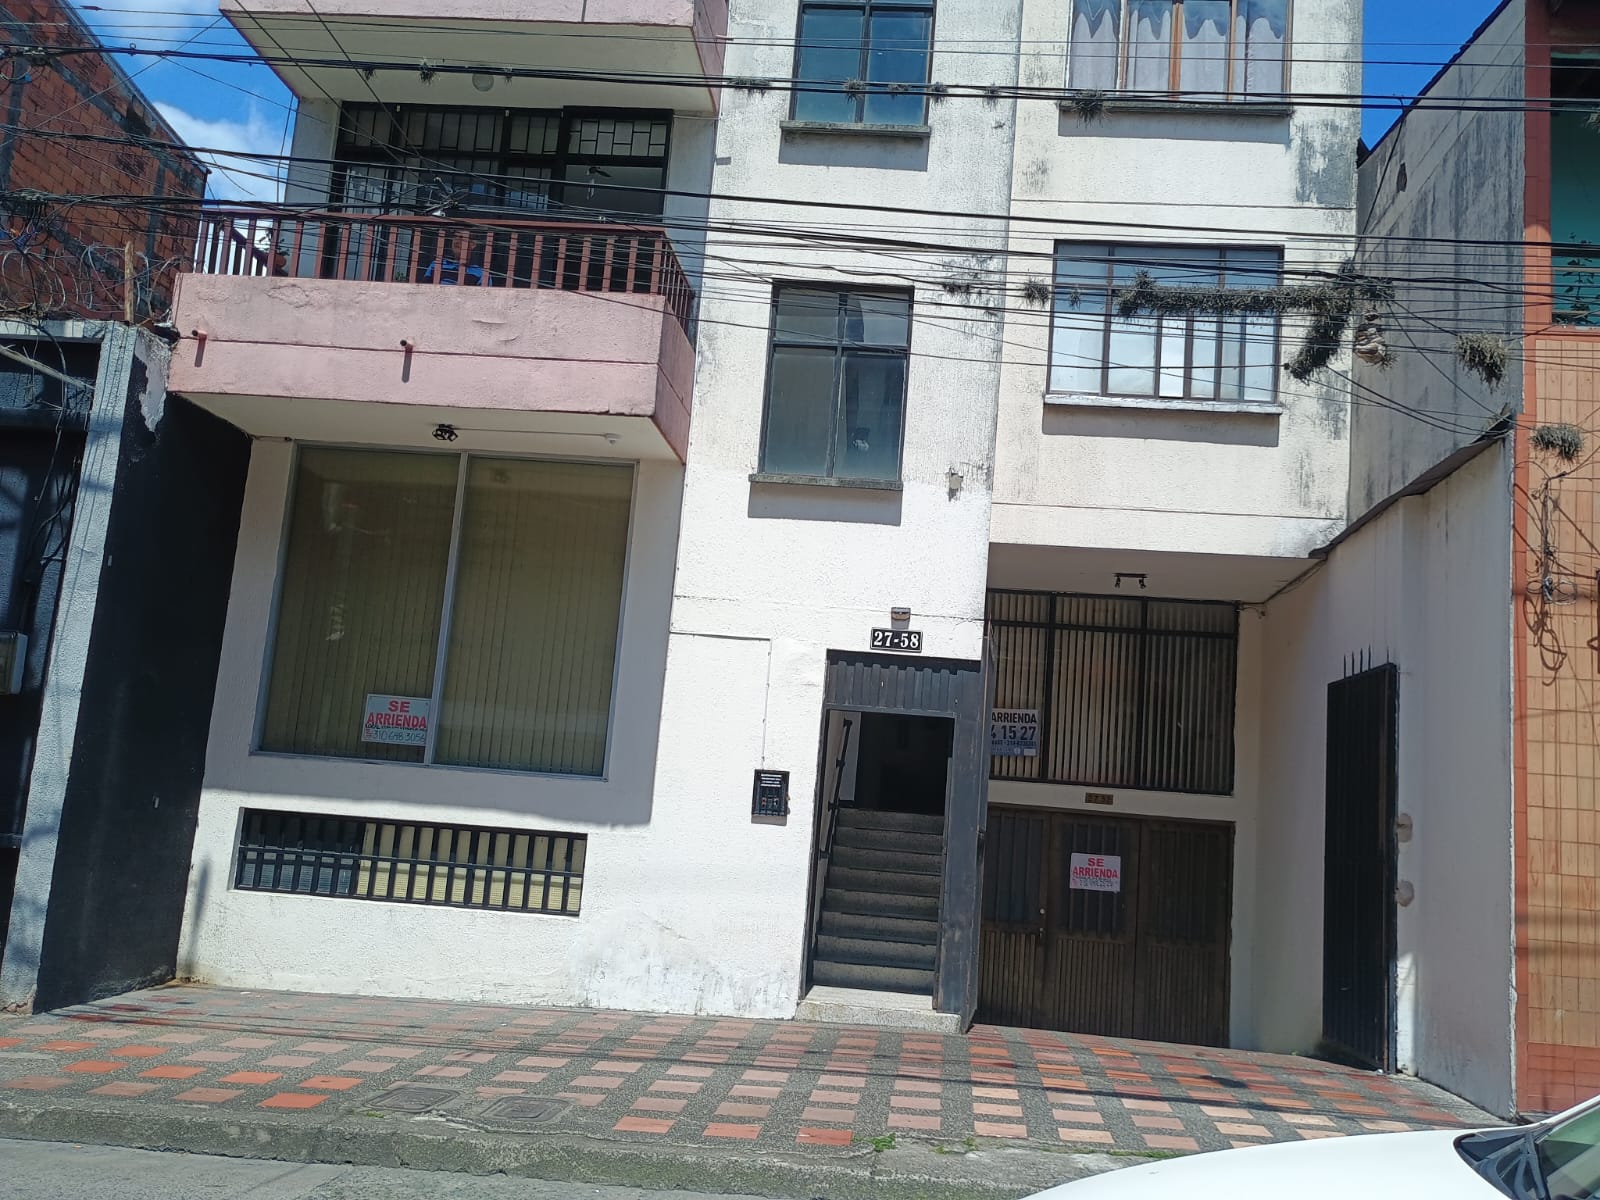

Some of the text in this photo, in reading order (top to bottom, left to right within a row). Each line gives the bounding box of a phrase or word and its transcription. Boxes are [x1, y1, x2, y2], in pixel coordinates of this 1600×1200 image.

[873, 631, 919, 648] 27-58
[388, 700, 410, 713] SE
[366, 712, 427, 728] ARRIENDA
[992, 711, 1037, 724] ARRIENDA
[1087, 857, 1104, 867] SE
[1072, 866, 1118, 879] ARRIENDA
